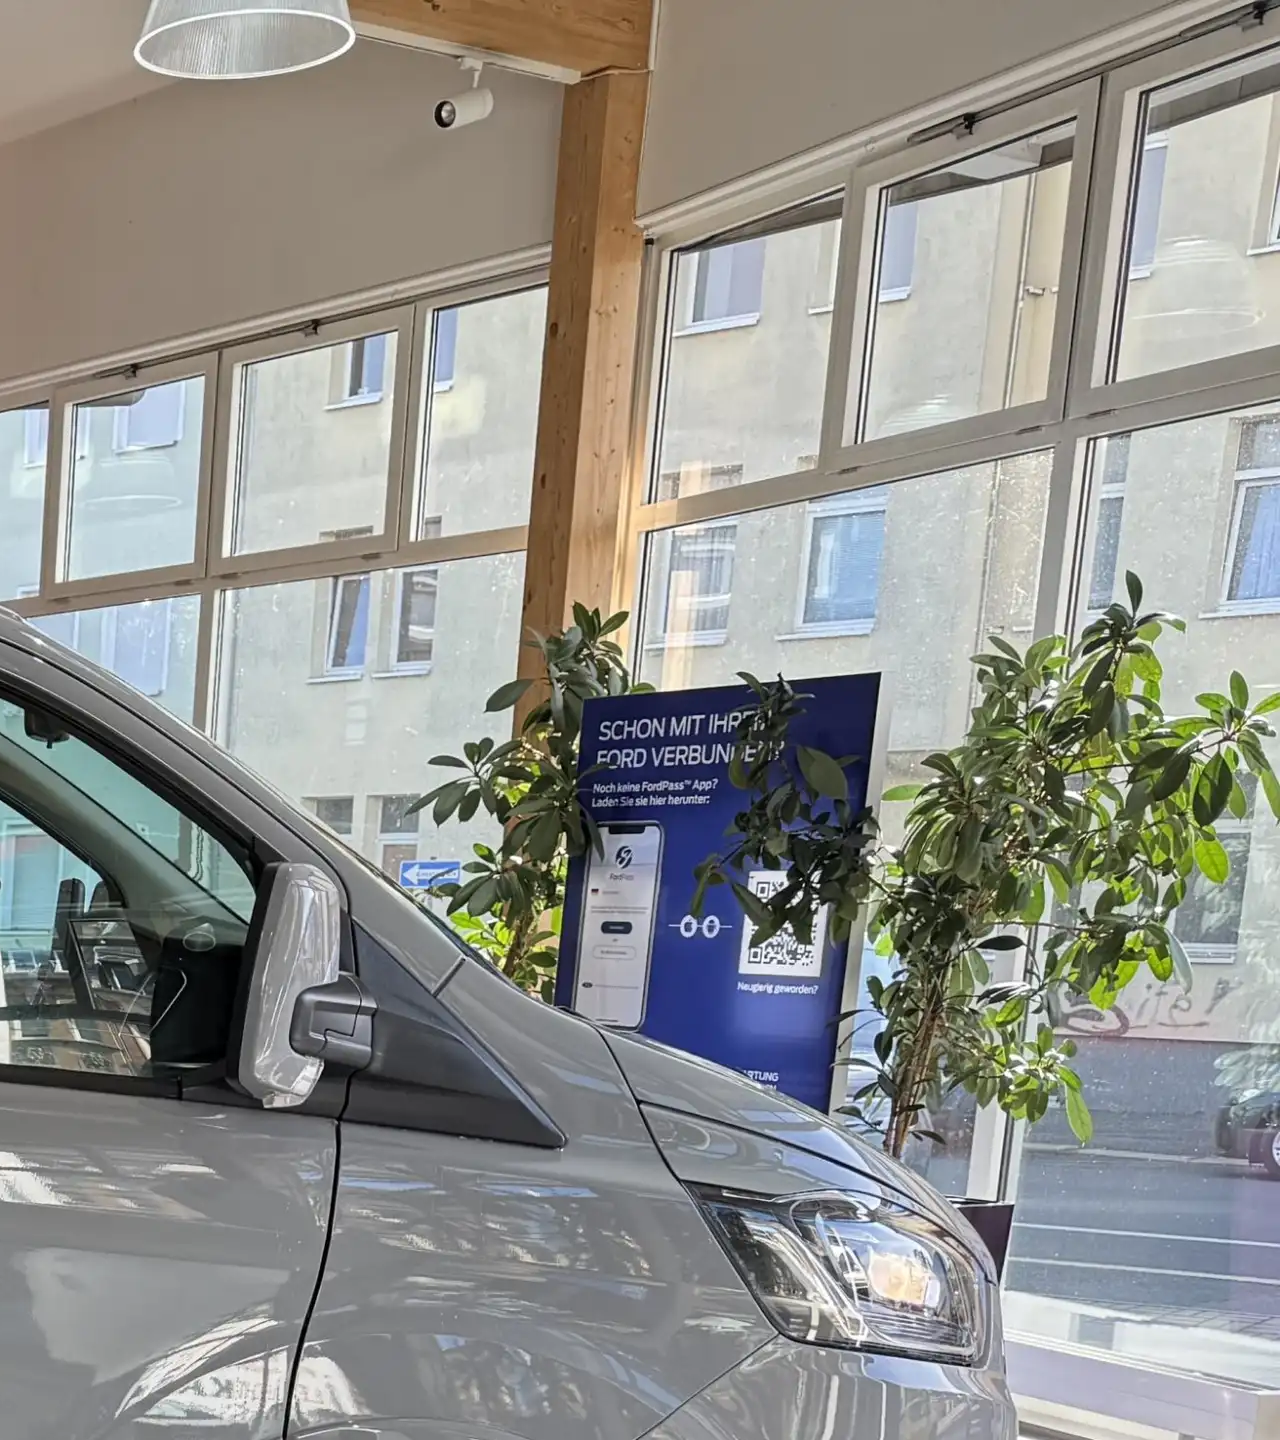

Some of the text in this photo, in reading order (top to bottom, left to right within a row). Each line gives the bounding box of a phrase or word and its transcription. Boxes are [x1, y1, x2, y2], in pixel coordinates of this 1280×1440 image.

[598, 717, 666, 741] SCHON
[669, 714, 706, 737] MIT
[596, 748, 648, 769] FORD
[593, 782, 616, 794] Noch
[617, 781, 641, 793] keine
[692, 778, 719, 792] App?
[592, 794, 710, 808] Laden Sie sie hier herunter:
[774, 984, 819, 995] geworden?
